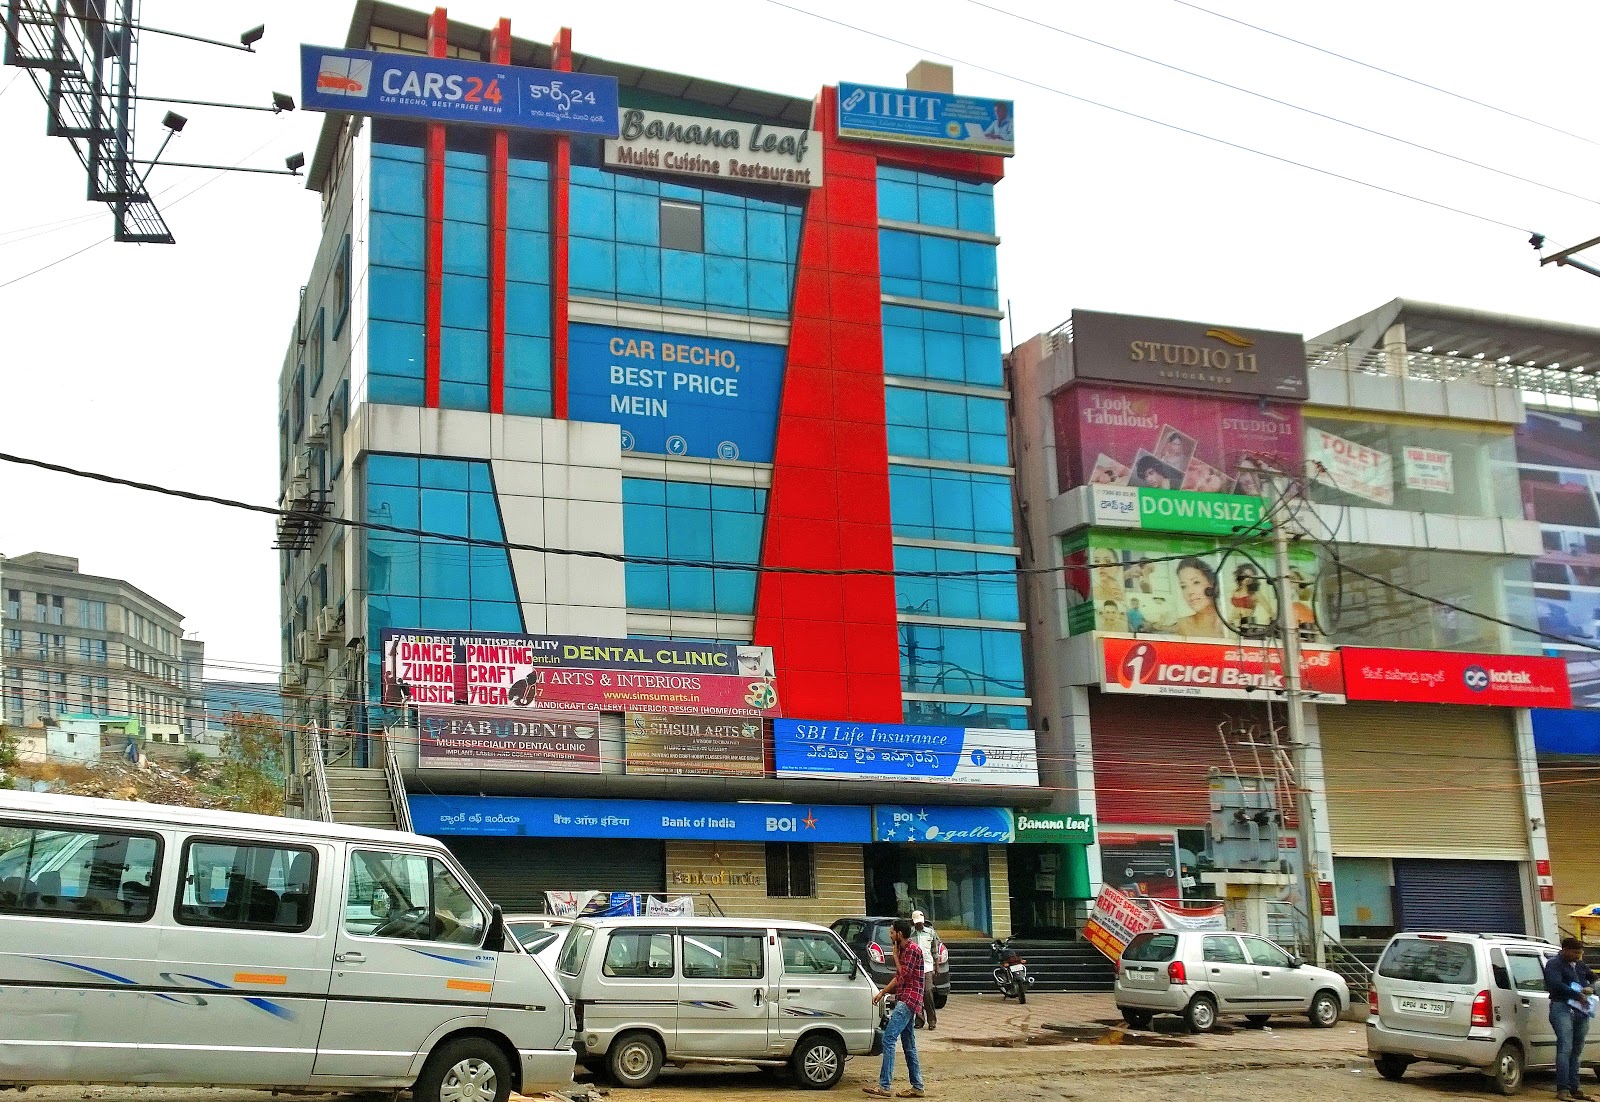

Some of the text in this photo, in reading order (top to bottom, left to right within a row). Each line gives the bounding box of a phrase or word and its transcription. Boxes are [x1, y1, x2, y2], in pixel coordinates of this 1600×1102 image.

[382, 69, 503, 104] CARS24
[432, 100, 451, 108] BEST
[867, 91, 941, 121] IIHT
[622, 109, 740, 149] Banana
[750, 124, 809, 163] Leaf
[618, 146, 811, 184] Multi Cuisine Restaurant
[610, 337, 741, 372] CAR BECHO,
[1131, 340, 1259, 374] STUDIO 11
[610, 365, 739, 397] BEST PRICE
[610, 394, 668, 418] MEIN
[1092, 394, 1132, 411] Look
[1083, 407, 1159, 429] Fabulous!
[1222, 418, 1277, 433] STUDIO
[1142, 496, 1255, 522] DOWNSIZE
[402, 643, 452, 662] DANCE
[460, 637, 559, 650] MULTISPECIALITY
[467, 645, 533, 665] PAINTING
[563, 645, 728, 667] DENTAL CLINIC
[402, 663, 453, 683] ZUMBA
[467, 664, 515, 684] CRAFT
[550, 672, 594, 686] ARTS
[600, 673, 612, 686] &
[617, 674, 701, 690] INTERIORS
[1158, 664, 1284, 688] ICICI Bank
[1488, 669, 1532, 684] kotak
[468, 686, 509, 705] YOGA
[603, 690, 700, 703] www.simsumarts.in
[629, 703, 667, 713] INTERIOR
[669, 705, 699, 714] DESIGN
[700, 706, 761, 717] (HOME/OFFICE)
[451, 719, 572, 738] FABUDENT
[650, 722, 739, 738] SIMSUM ARTS
[795, 725, 948, 746] SBI Life Insurance
[436, 739, 586, 752] MULTISPECIALITY DENTAL CLINIC
[662, 816, 736, 829] Bank of India
[766, 817, 797, 832] BOI
[893, 812, 913, 822] BOI
[1018, 816, 1090, 833] Banana Leaf
[672, 869, 761, 886] Bank of India
[1097, 894, 1117, 917] RENT
[1104, 888, 1125, 906] OFFICE
[1122, 899, 1142, 919] SPACE
